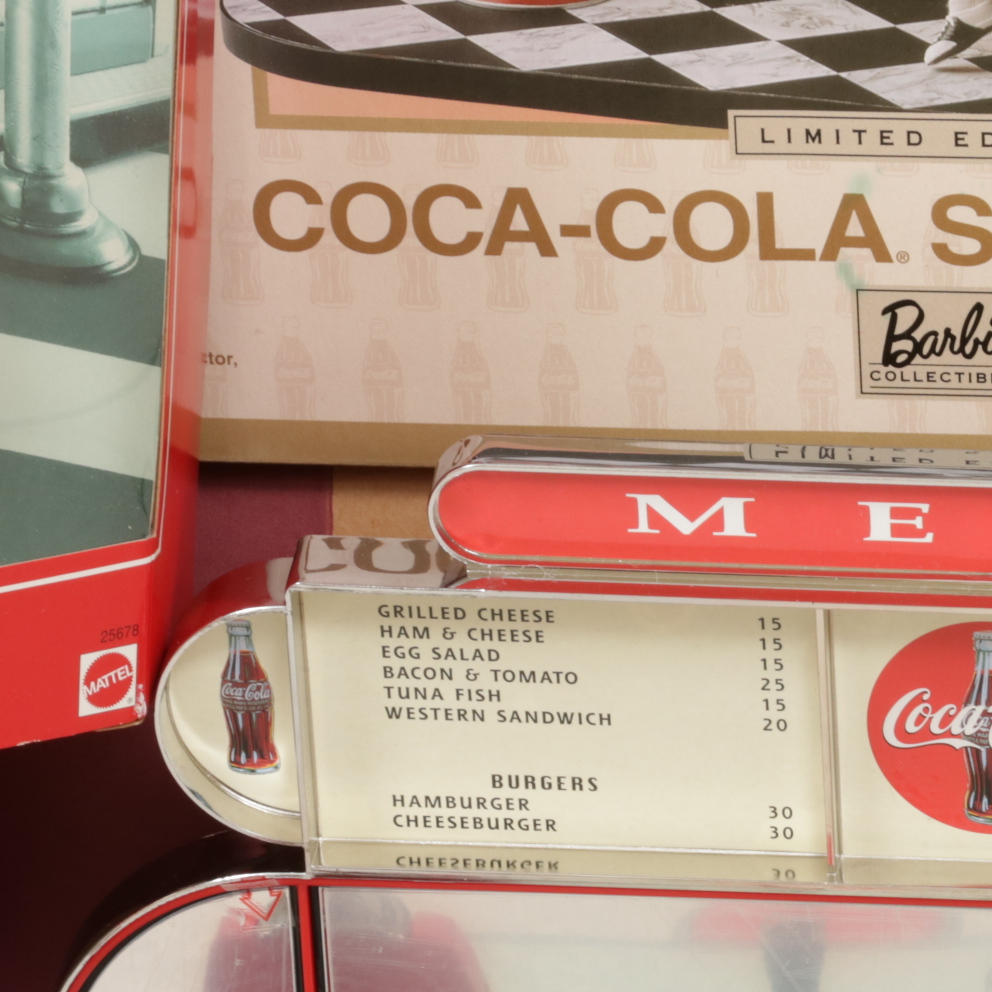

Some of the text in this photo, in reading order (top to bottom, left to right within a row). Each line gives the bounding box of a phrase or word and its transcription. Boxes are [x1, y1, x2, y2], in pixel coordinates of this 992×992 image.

[759, 127, 923, 147] LIMITED
[378, 605, 781, 630] GRILLED CHEESE 15
[100, 623, 140, 643] 25678
[380, 625, 782, 651] HAM & CHEESE 15
[382, 646, 783, 671] EGG SALAD 15
[82, 664, 135, 698] MATTEL
[383, 666, 784, 691] BACON & TOMATO 25
[221, 682, 271, 701] Coca-Cola
[383, 686, 785, 711] TUNA FISH 15
[385, 706, 787, 732] WESTERN SANDWICH 20
[491, 774, 598, 791] BURGERS
[392, 795, 792, 819] HAMBURGER 30
[393, 814, 793, 840] CHEESEBURGER 30
